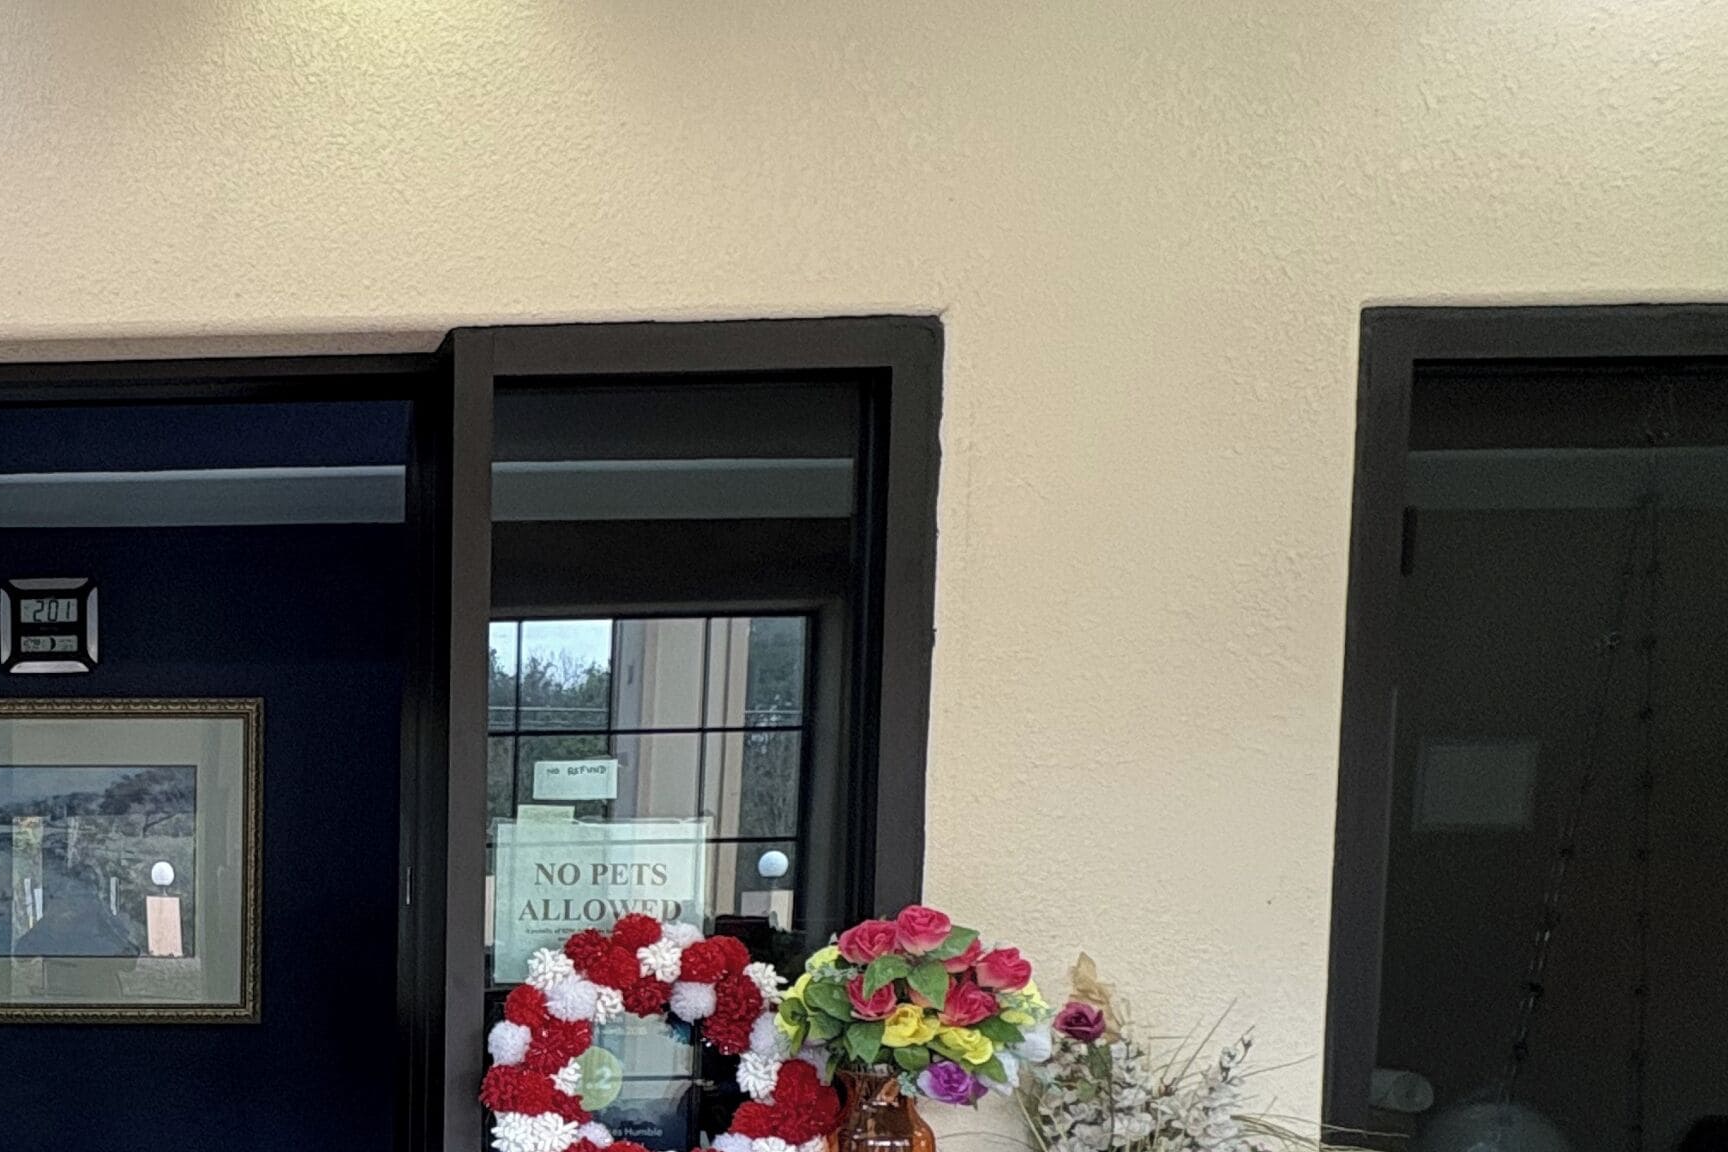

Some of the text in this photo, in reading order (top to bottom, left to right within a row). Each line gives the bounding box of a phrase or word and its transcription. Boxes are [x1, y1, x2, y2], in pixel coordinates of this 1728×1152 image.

[534, 862, 668, 886] NO PETS
[518, 898, 682, 922] ALLOWED
